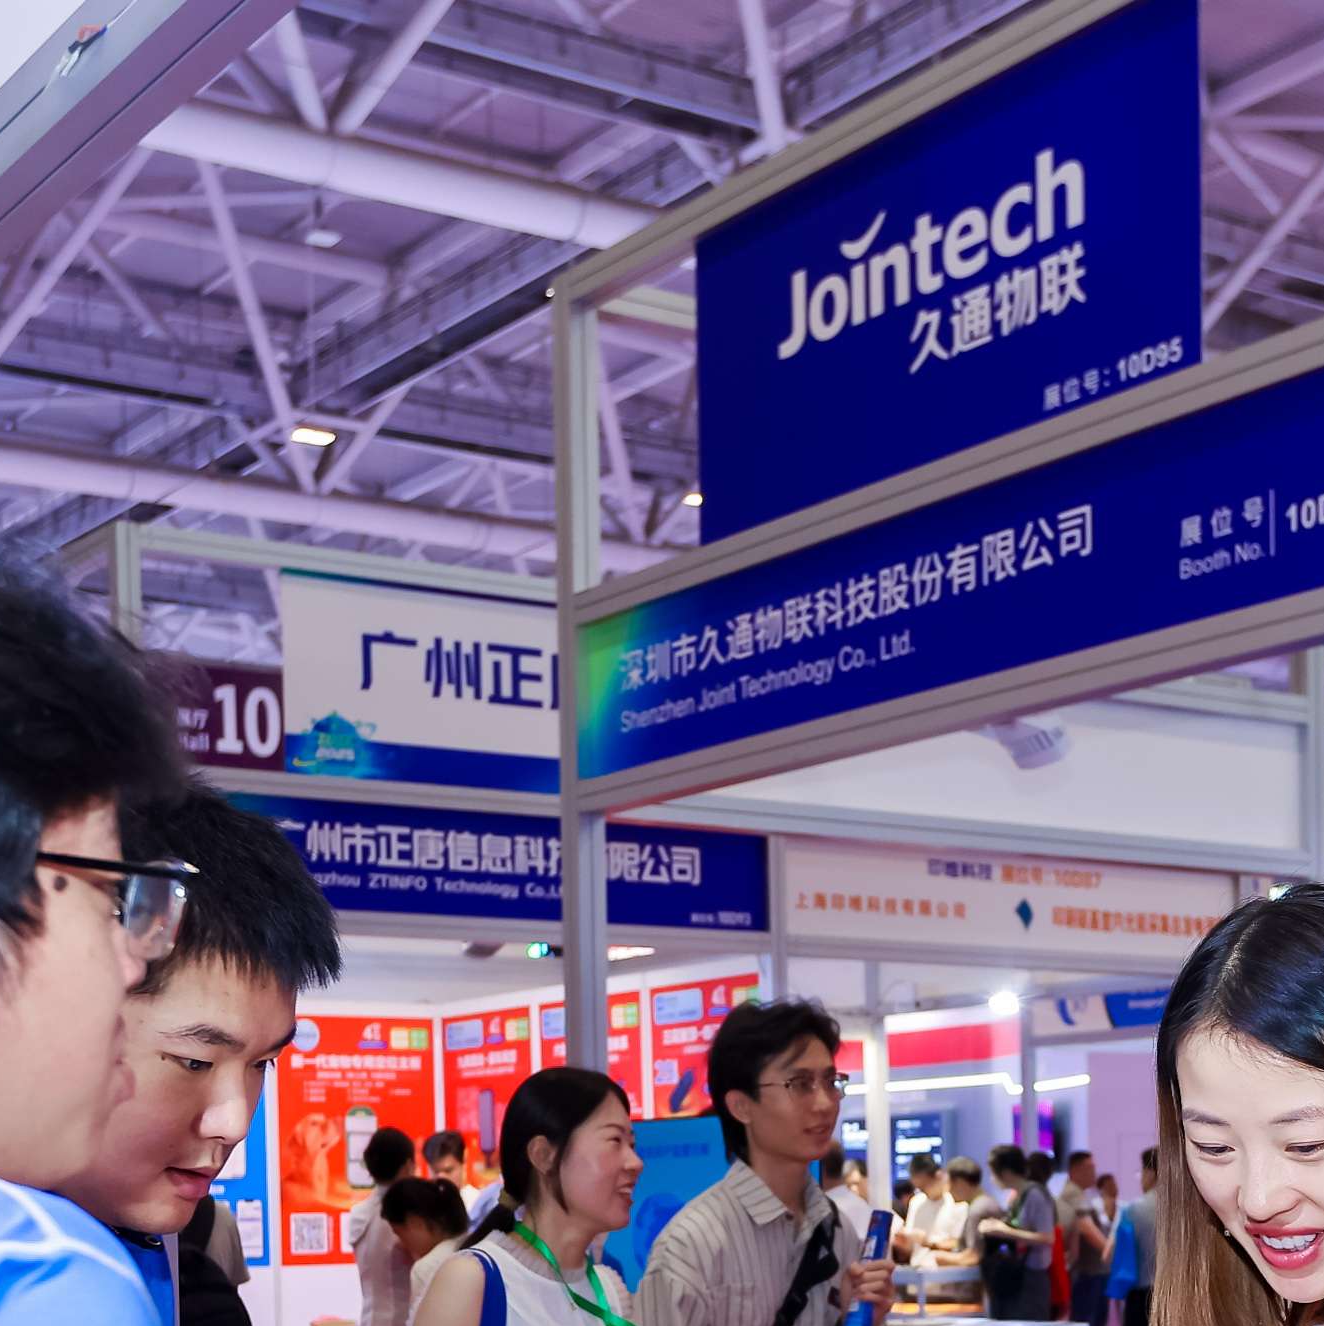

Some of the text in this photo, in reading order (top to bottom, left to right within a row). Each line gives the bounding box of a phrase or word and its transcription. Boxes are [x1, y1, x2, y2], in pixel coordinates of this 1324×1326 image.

[778, 147, 1086, 359] Jointech
[909, 243, 1087, 374] 久通物联
[619, 505, 1094, 690] 深圳市久通物联科技股份有限公司
[1179, 542, 1266, 580] Booth No.
[213, 684, 281, 758] 10
[361, 631, 560, 709] 广州正
[620, 692, 695, 734] Shenzhen
[698, 676, 737, 712] Joint
[739, 650, 835, 706] Technology
[879, 629, 915, 663] Ltd.
